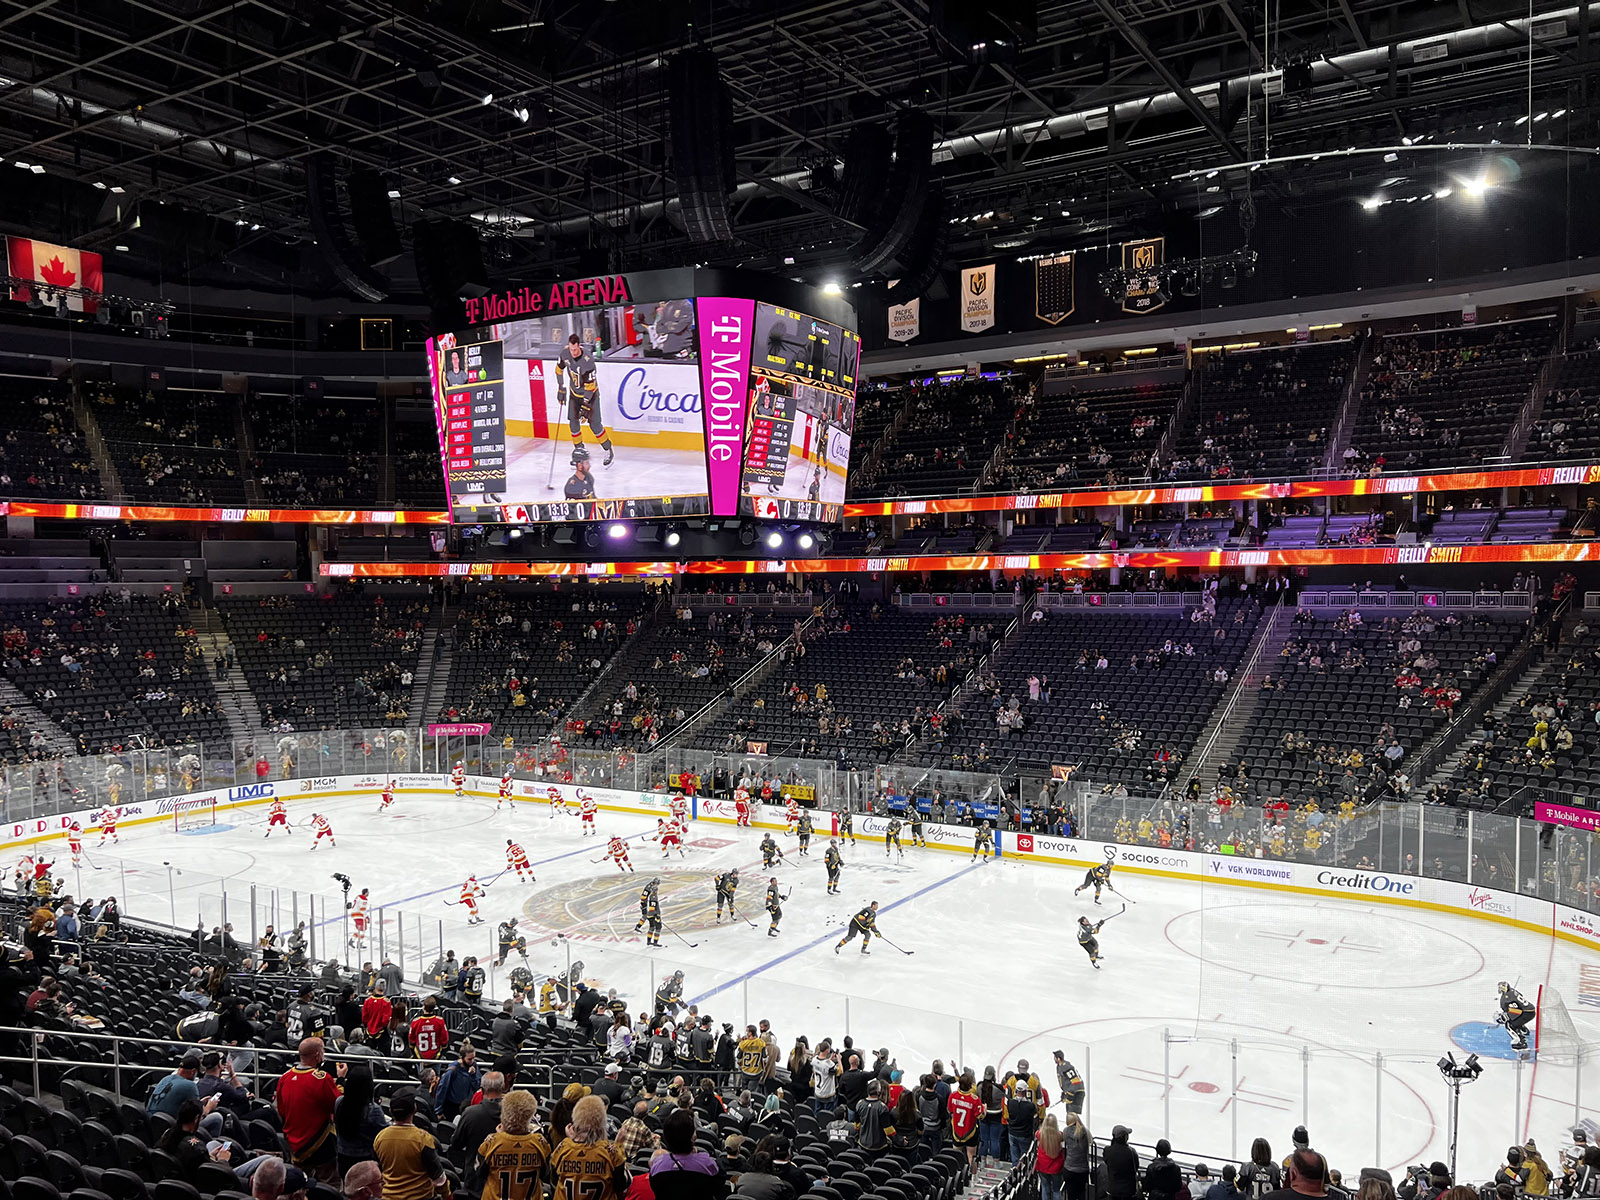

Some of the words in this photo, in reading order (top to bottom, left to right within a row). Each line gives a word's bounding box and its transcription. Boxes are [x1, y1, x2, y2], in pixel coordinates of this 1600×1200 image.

[482, 287, 543, 321] Mobile
[548, 275, 629, 310] ARENA
[968, 298, 987, 306] PACIFIC
[1136, 298, 1151, 307] 2018
[895, 308, 913, 316] PACIFIC
[963, 309, 992, 318] CHAMPIONS
[967, 304, 988, 312] DIVISION
[891, 319, 917, 328] CHAMPIONS
[894, 314, 914, 322] DIVISION
[969, 319, 987, 328] 2017-18
[894, 328, 914, 337] 2019-20
[618, 367, 703, 421] Circa
[709, 350, 741, 461] Mobile
[831, 432, 849, 460] Circa
[1552, 466, 1588, 485] REILLY
[467, 482, 485, 492] UMC
[1384, 477, 1419, 492] FORWARD
[1015, 495, 1038, 509] REILLY
[1038, 494, 1063, 508] SMITH
[222, 508, 246, 521] REILLY
[246, 509, 270, 521] SMITH
[532, 504, 540, 522] 0
[547, 503, 569, 516] 13:13
[577, 503, 585, 520] 0
[783, 500, 790, 518] 0
[815, 503, 822, 521] 0
[1397, 547, 1429, 563] REILLY
[1429, 547, 1463, 563] SMITH
[448, 563, 471, 576] REILLY
[471, 563, 493, 576] SMITH
[866, 558, 887, 571] REILLY
[887, 558, 909, 571] SMITH
[313, 778, 337, 786] MGM
[228, 784, 274, 801] UMC
[155, 797, 199, 815] William
[1554, 810, 1580, 822] Mobile
[928, 825, 973, 841] Wynn
[511, 847, 523, 858] 55
[612, 842, 623, 852] 20
[1037, 840, 1077, 853] TOYOTA
[1122, 852, 1188, 868] SOCIOS.com
[1228, 864, 1243, 875] VGK
[1245, 866, 1291, 880] WORLDWIDE
[1317, 871, 1413, 894] CreditOne
[1469, 888, 1493, 909] Virgin
[1485, 902, 1512, 912] HOTELS
[472, 978, 483, 992] 61
[418, 1031, 438, 1052] 61
[676, 1040, 690, 1057] 54
[649, 1047, 664, 1066] 19
[743, 1051, 761, 1068] 27
[956, 1107, 967, 1128] 7
[492, 1153, 519, 1167] VEGAS
[584, 1161, 606, 1175] BORN
[499, 1170, 539, 1200] 17
[564, 1178, 605, 1200] 17
